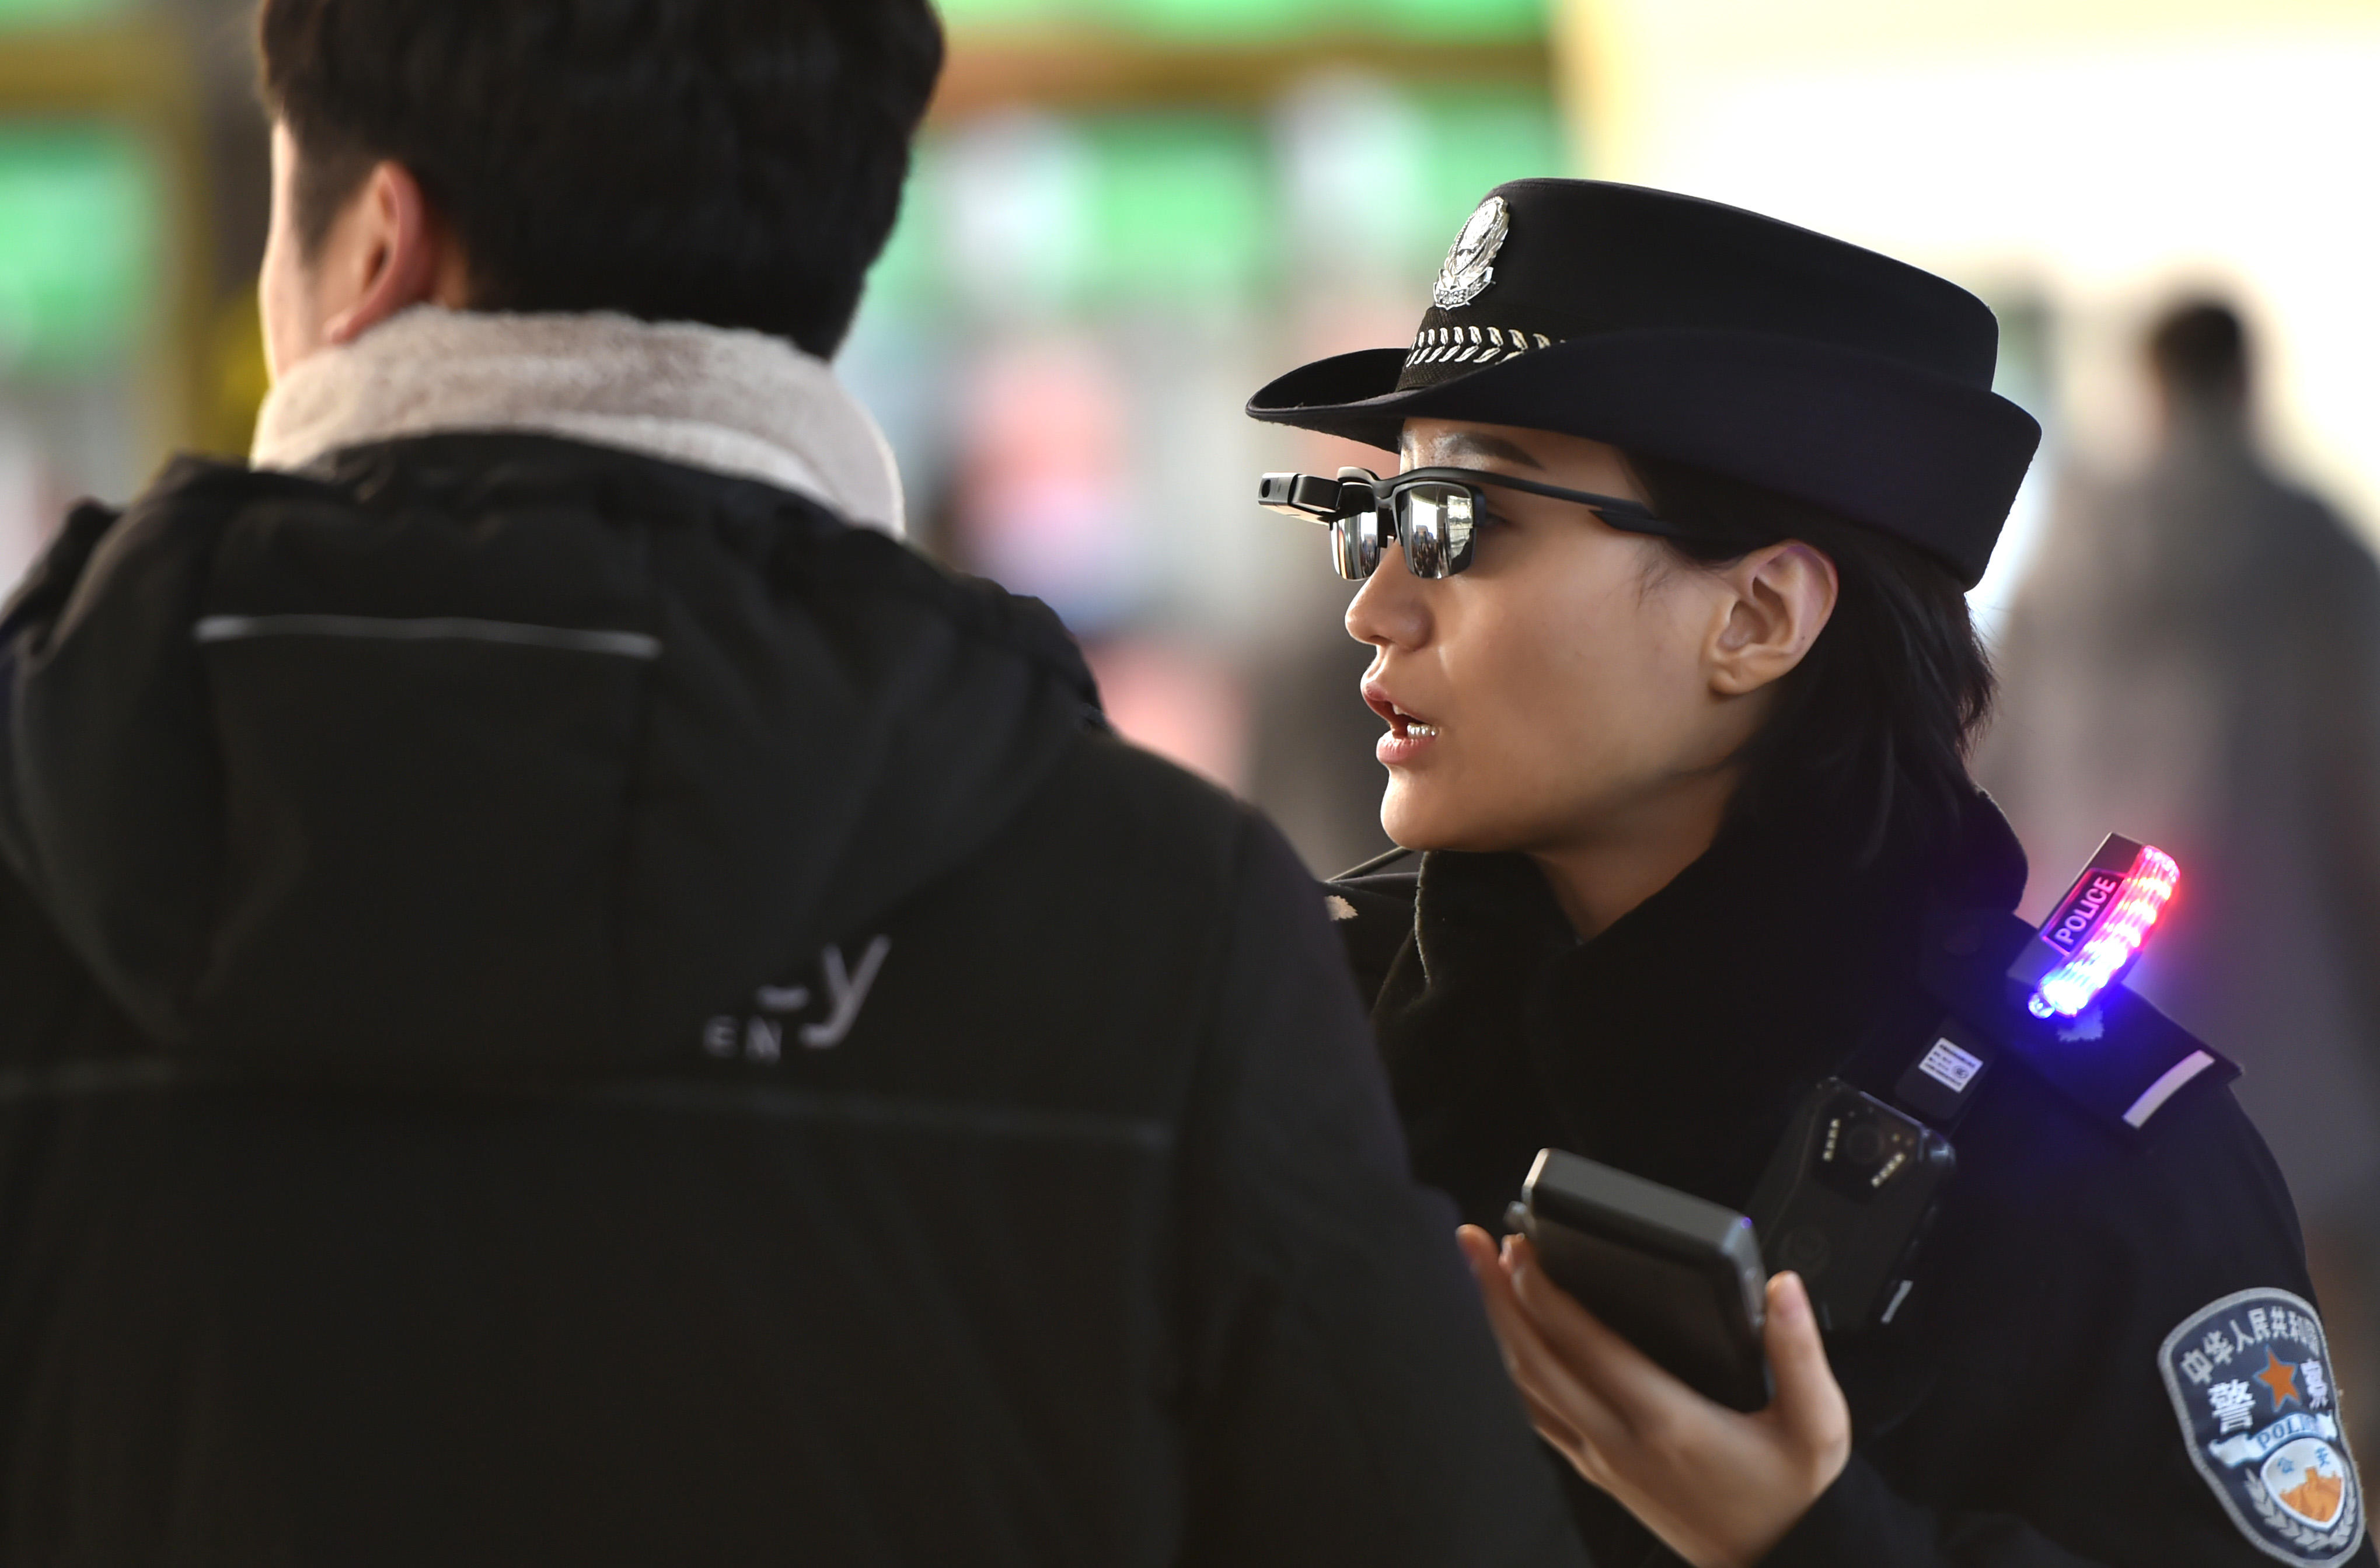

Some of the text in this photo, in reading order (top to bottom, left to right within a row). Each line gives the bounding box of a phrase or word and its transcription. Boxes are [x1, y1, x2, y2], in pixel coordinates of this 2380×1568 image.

[2054, 877, 2117, 946] POLICE
[759, 934, 892, 1048] y
[2207, 1379, 2256, 1433] 警
